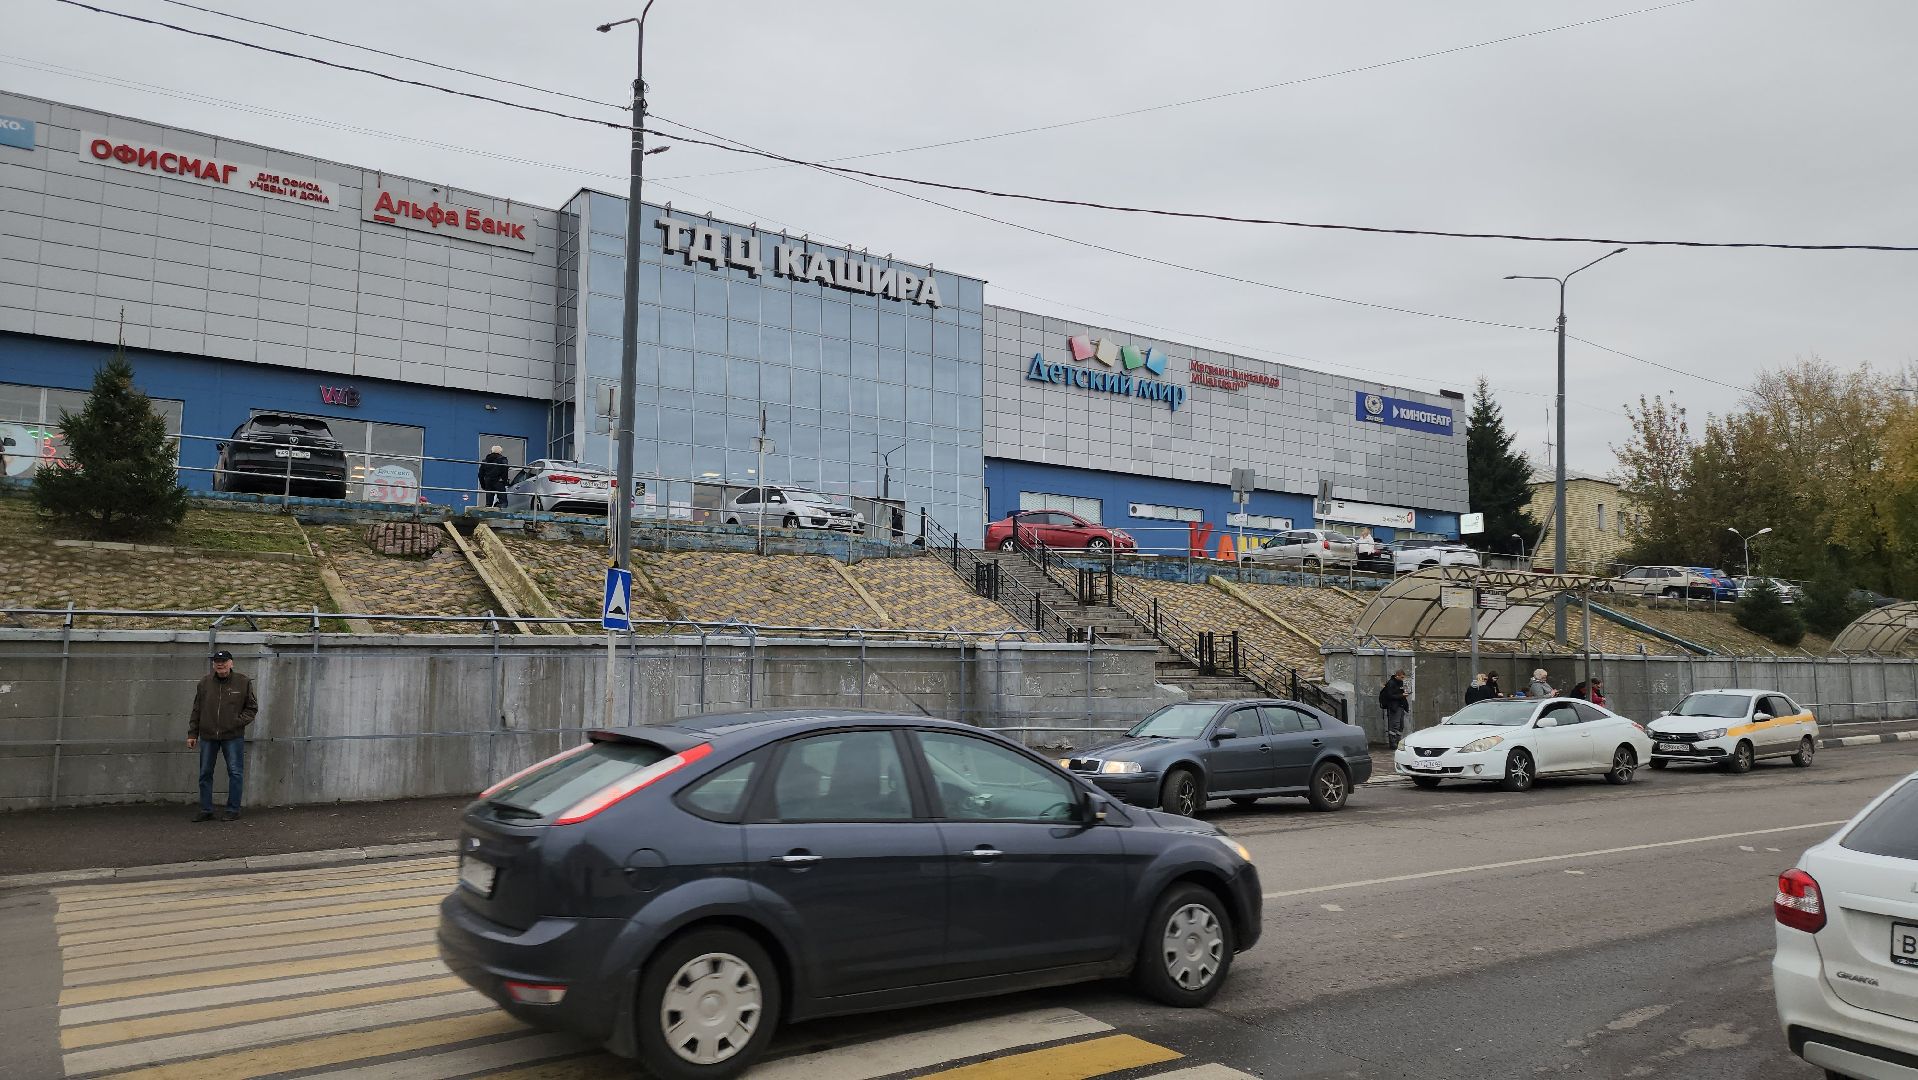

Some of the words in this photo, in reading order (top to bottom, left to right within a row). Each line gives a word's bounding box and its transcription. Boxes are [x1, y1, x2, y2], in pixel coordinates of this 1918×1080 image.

[91, 139, 238, 184] ОФИСМАГ
[249, 180, 287, 196] УЧЕБЫ
[290, 188, 297, 198] И
[299, 190, 330, 204] ДОМА
[257, 172, 280, 184] ДЛЯ
[282, 177, 323, 193] ОФИСА,
[374, 191, 459, 228] Альфа
[465, 208, 526, 240] Банк
[656, 216, 763, 277] ТДЦ
[775, 243, 943, 308] КАШИРА
[320, 384, 360, 407] WB
[1027, 352, 1135, 395] Детский
[1136, 379, 1187, 411] мир
[1400, 407, 1452, 427] КИНОТЕАТР
